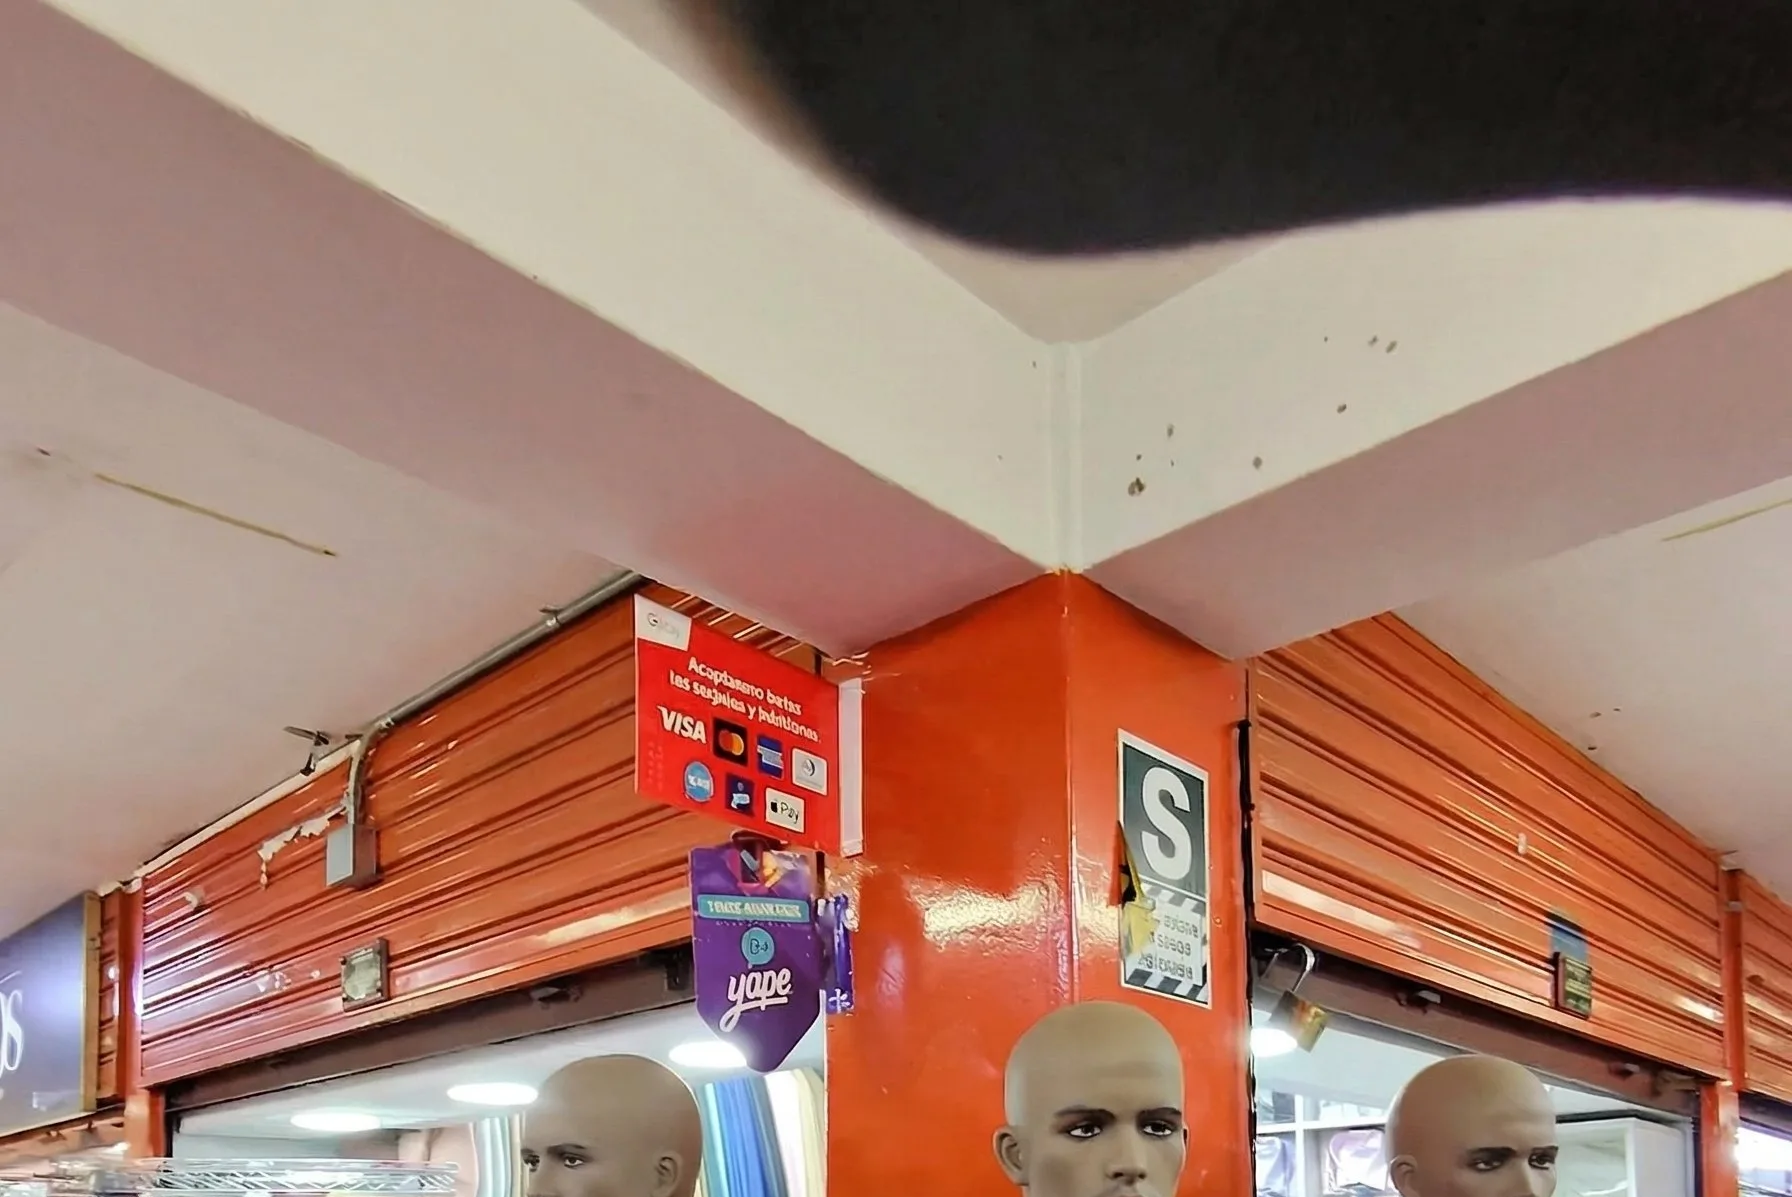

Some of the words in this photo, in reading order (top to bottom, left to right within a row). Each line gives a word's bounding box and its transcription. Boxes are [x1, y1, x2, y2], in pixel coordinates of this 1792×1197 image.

[657, 705, 707, 744] VISA
[1141, 766, 1192, 881] S
[719, 967, 793, 1033] yape
